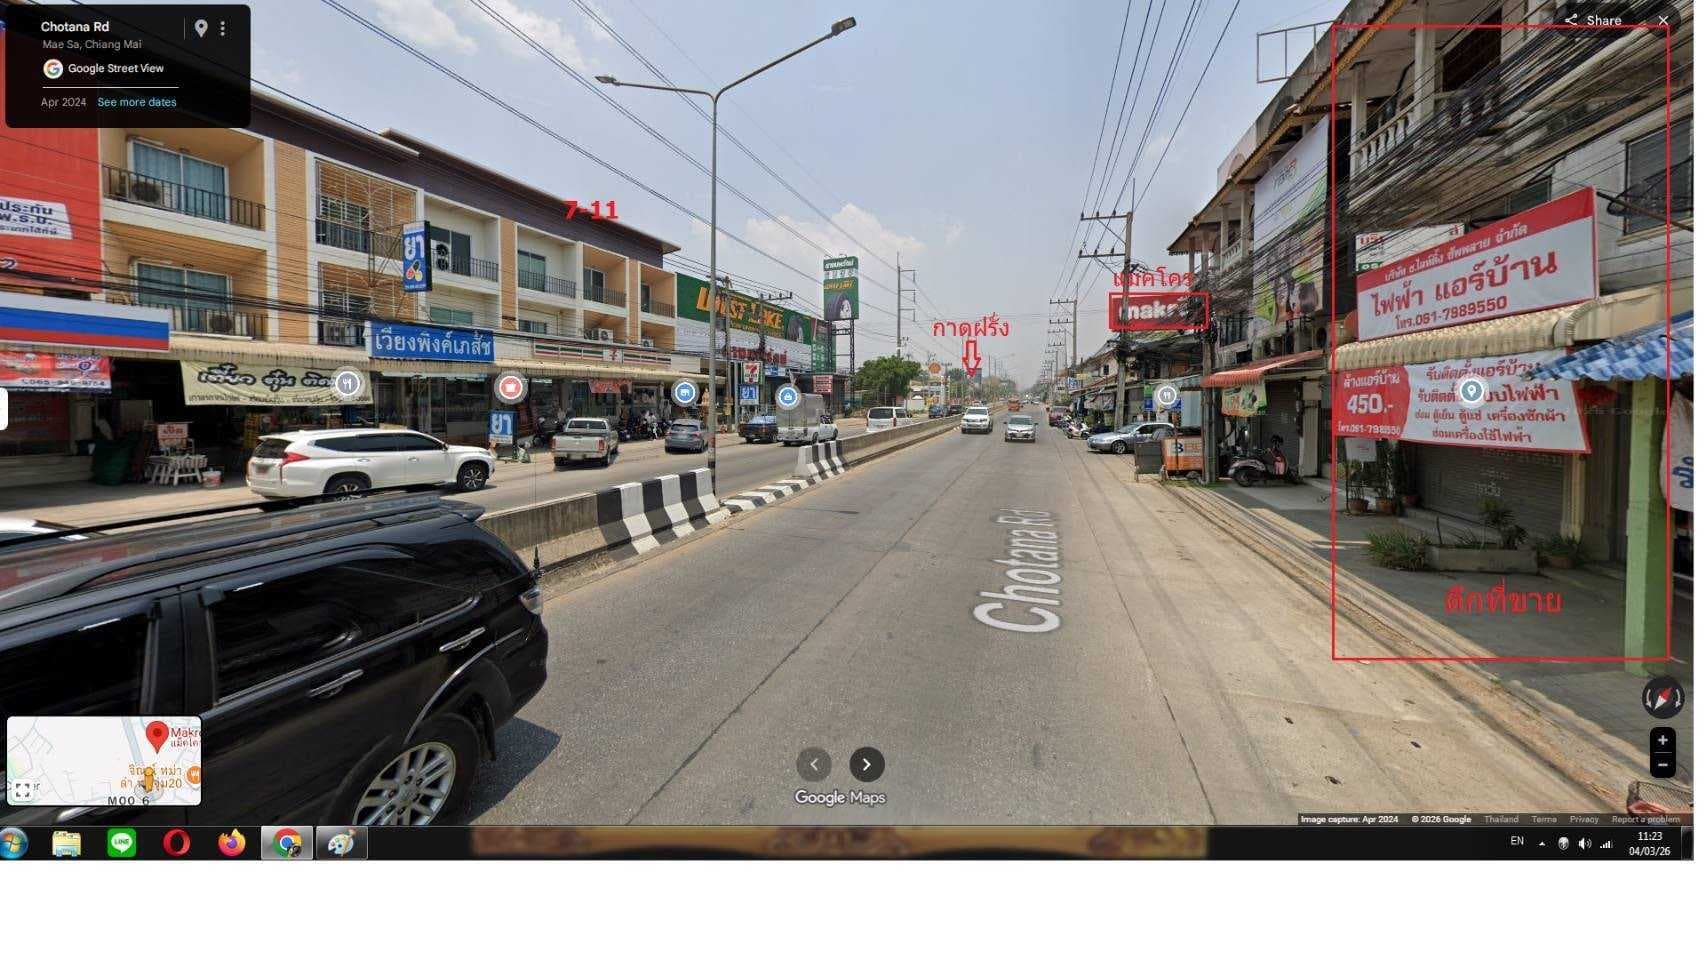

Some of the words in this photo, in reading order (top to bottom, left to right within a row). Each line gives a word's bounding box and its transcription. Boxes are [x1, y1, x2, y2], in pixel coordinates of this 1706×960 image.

[404, 235, 425, 261] ยา
[1371, 279, 1424, 317] ไฟฟ้า
[1435, 250, 1558, 302] แอร์บ้าน
[491, 413, 512, 435] ยา
